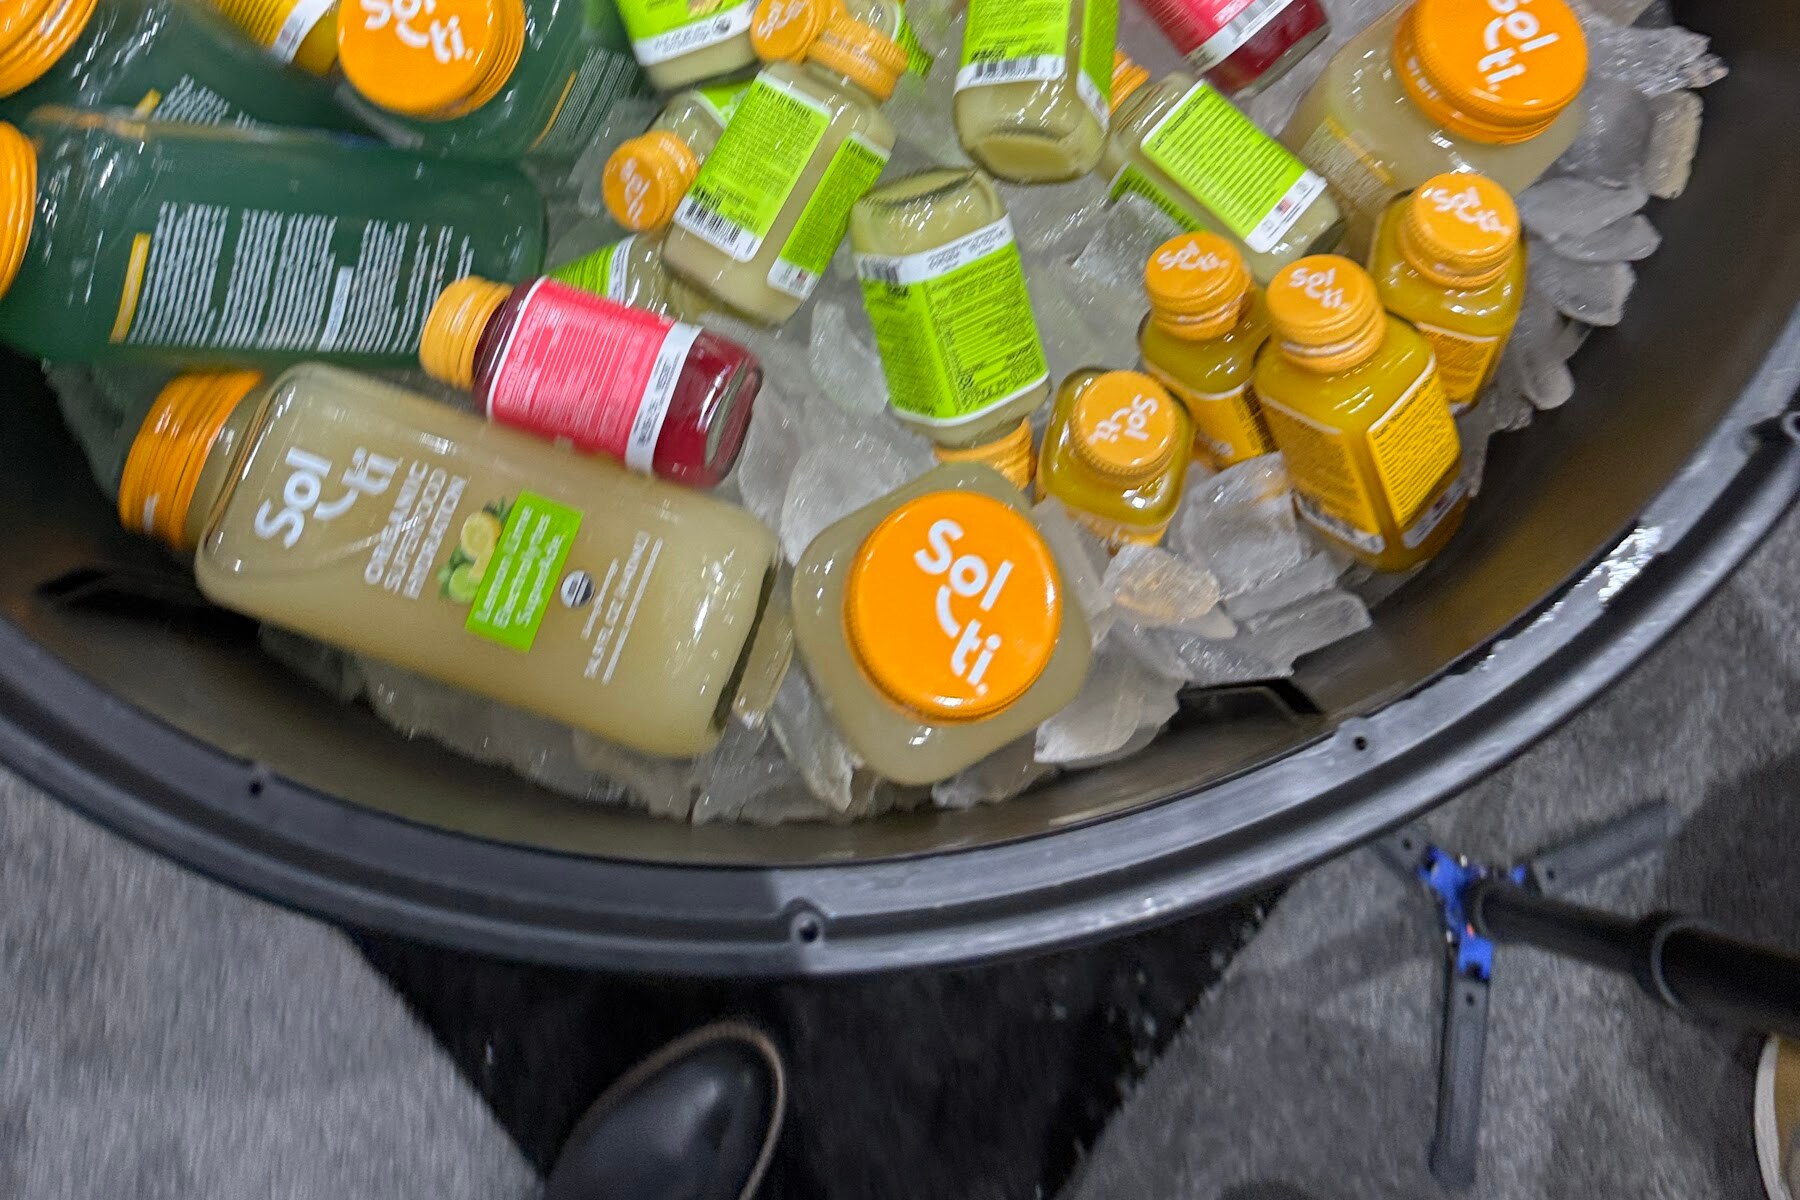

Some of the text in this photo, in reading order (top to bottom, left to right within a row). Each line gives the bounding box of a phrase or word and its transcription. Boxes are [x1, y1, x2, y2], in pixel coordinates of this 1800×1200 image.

[1288, 266, 1337, 289] Sol
[254, 446, 333, 550] Sol
[914, 518, 1014, 612] Sol
